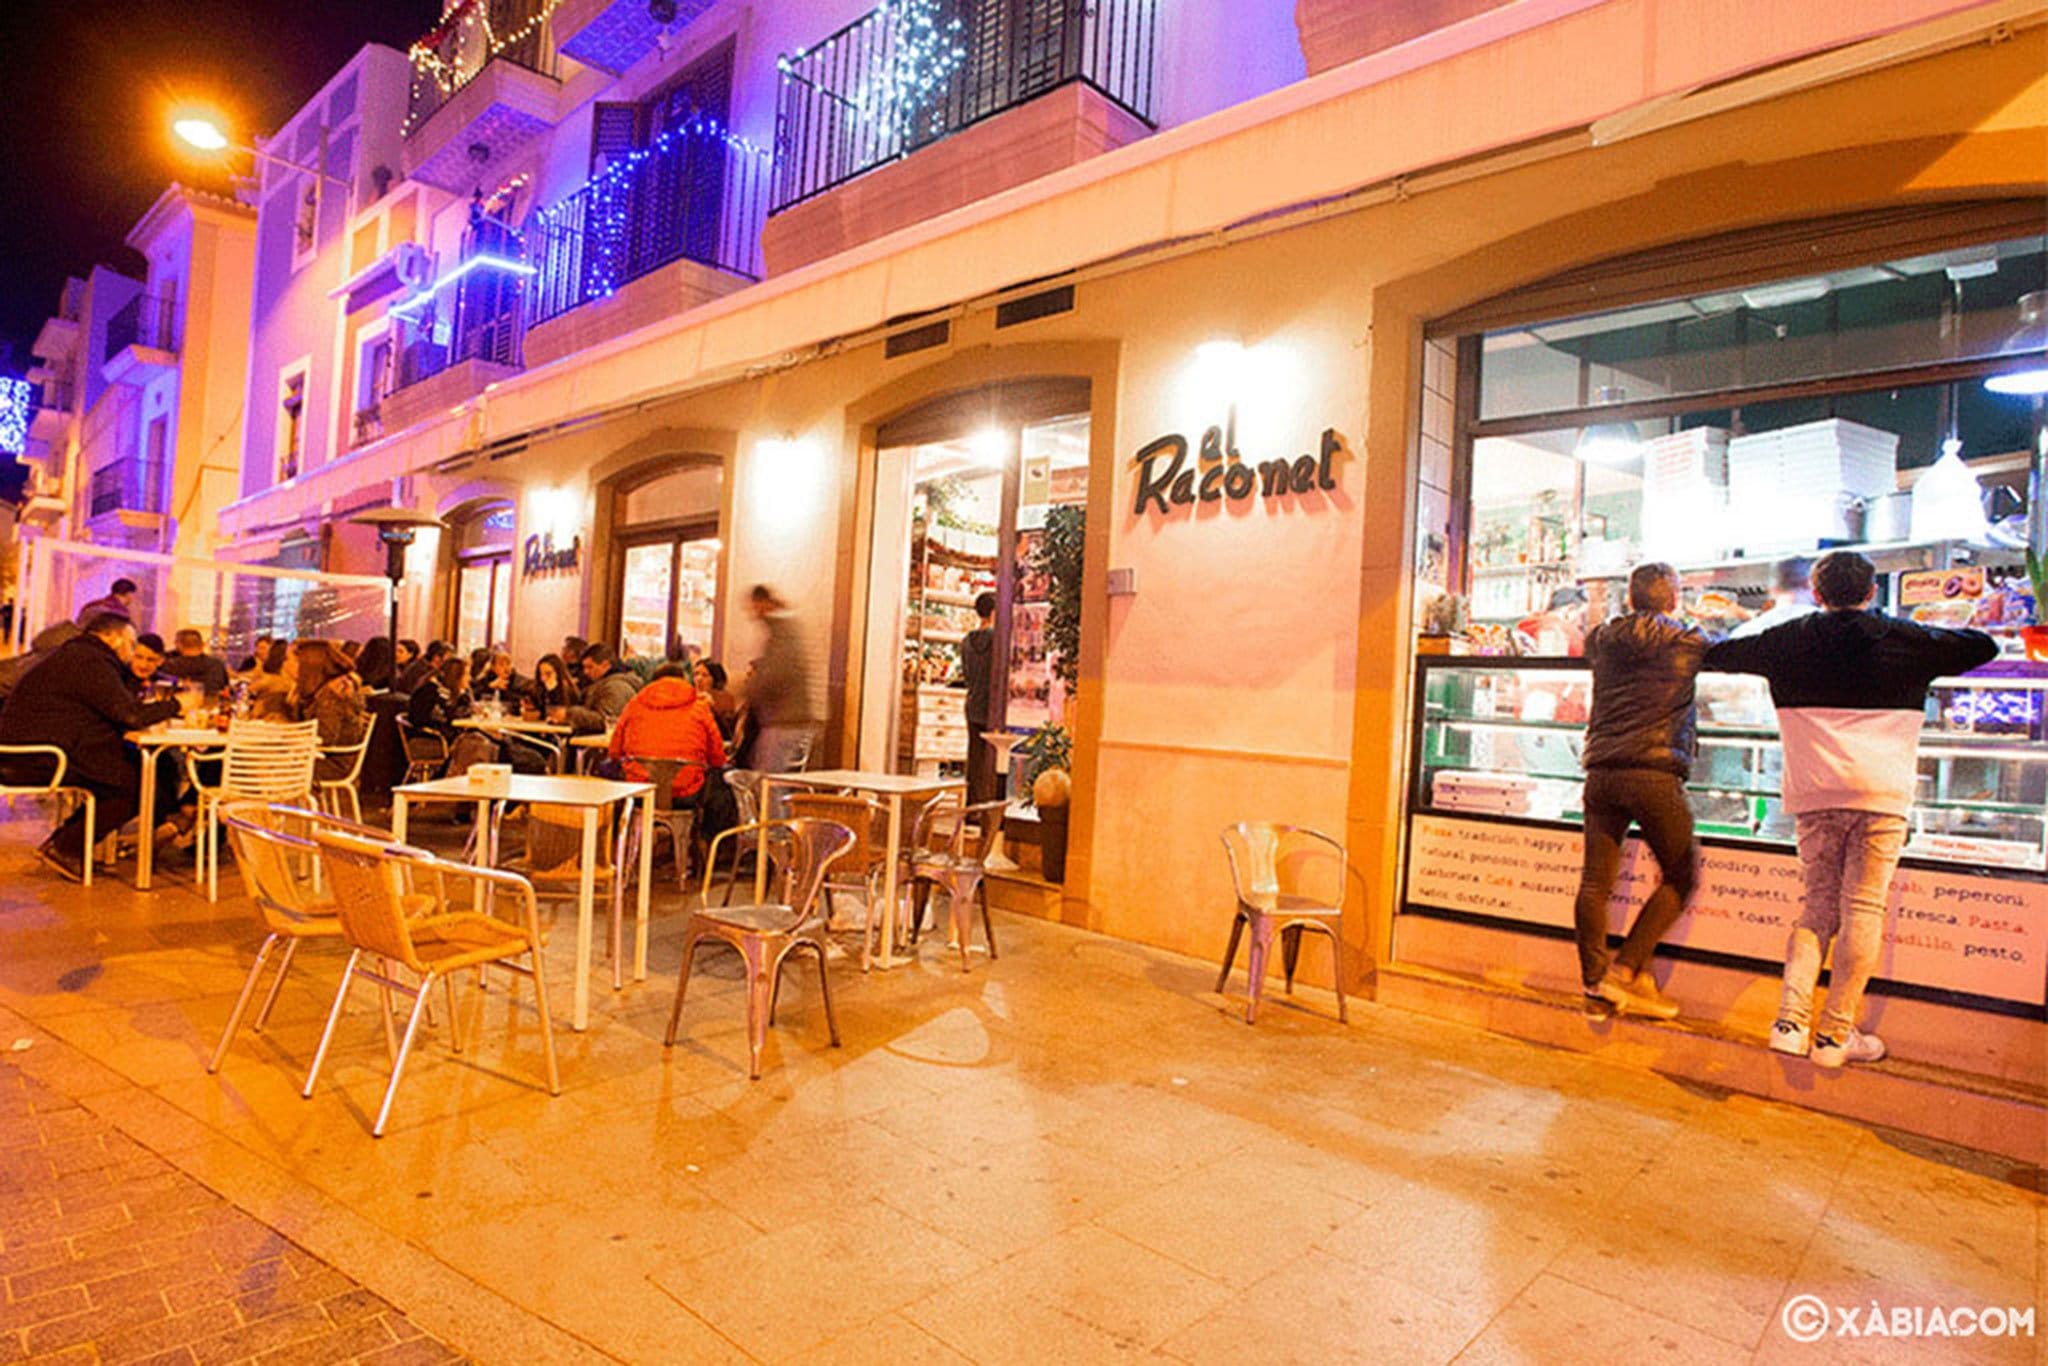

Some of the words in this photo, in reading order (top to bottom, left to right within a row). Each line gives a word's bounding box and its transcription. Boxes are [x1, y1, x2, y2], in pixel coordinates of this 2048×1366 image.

[1135, 428, 1342, 515] Raconet
[1700, 857, 1761, 877] fooding
[1881, 931, 1957, 952] cadillo.
